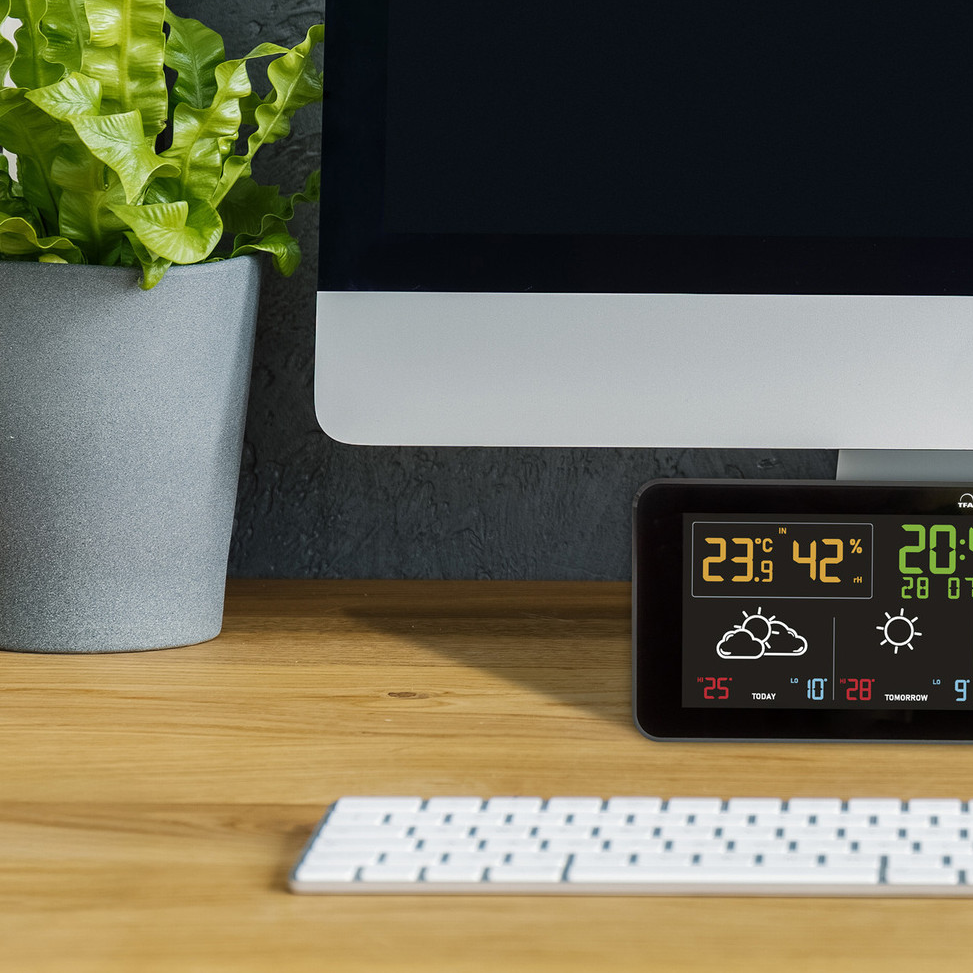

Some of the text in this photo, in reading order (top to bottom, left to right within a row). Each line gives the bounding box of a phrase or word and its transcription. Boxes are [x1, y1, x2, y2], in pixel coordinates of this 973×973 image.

[778, 527, 787, 535] IN
[792, 538, 844, 583] 42
[853, 576, 863, 584] rH
[901, 577, 929, 599] 28
[751, 692, 777, 700] TODAY
[884, 694, 929, 702] TOMORROW
